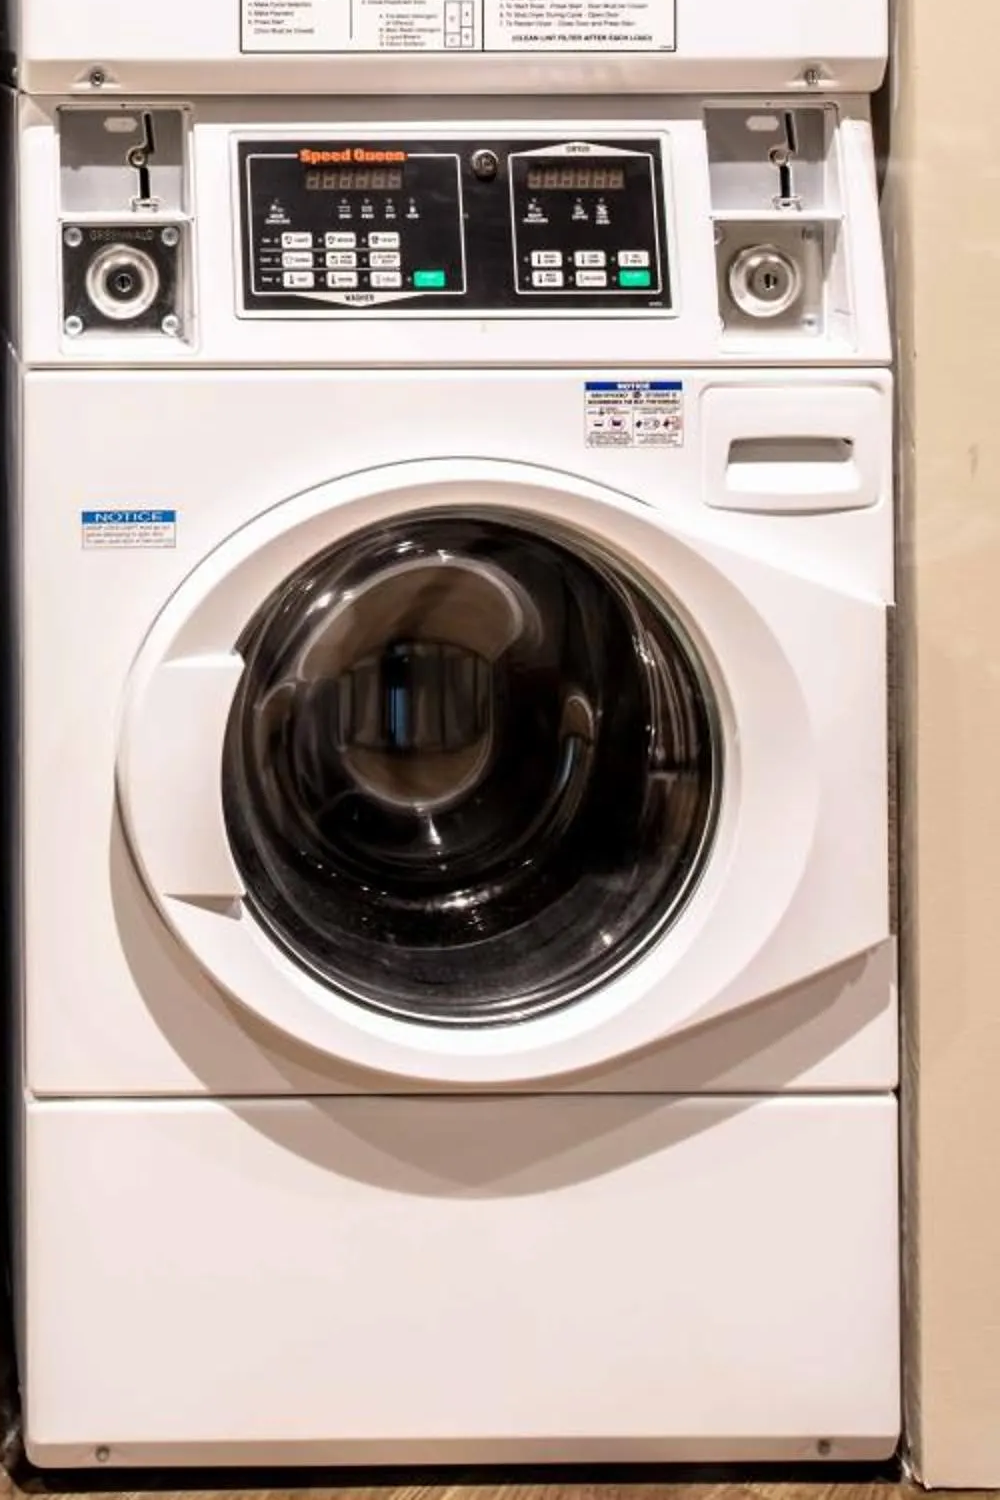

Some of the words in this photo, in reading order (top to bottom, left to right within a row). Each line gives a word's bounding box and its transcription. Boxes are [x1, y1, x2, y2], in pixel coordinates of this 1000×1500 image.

[300, 148, 350, 164] Speed
[353, 149, 405, 162] Queen
[95, 512, 162, 522] NOTICE
